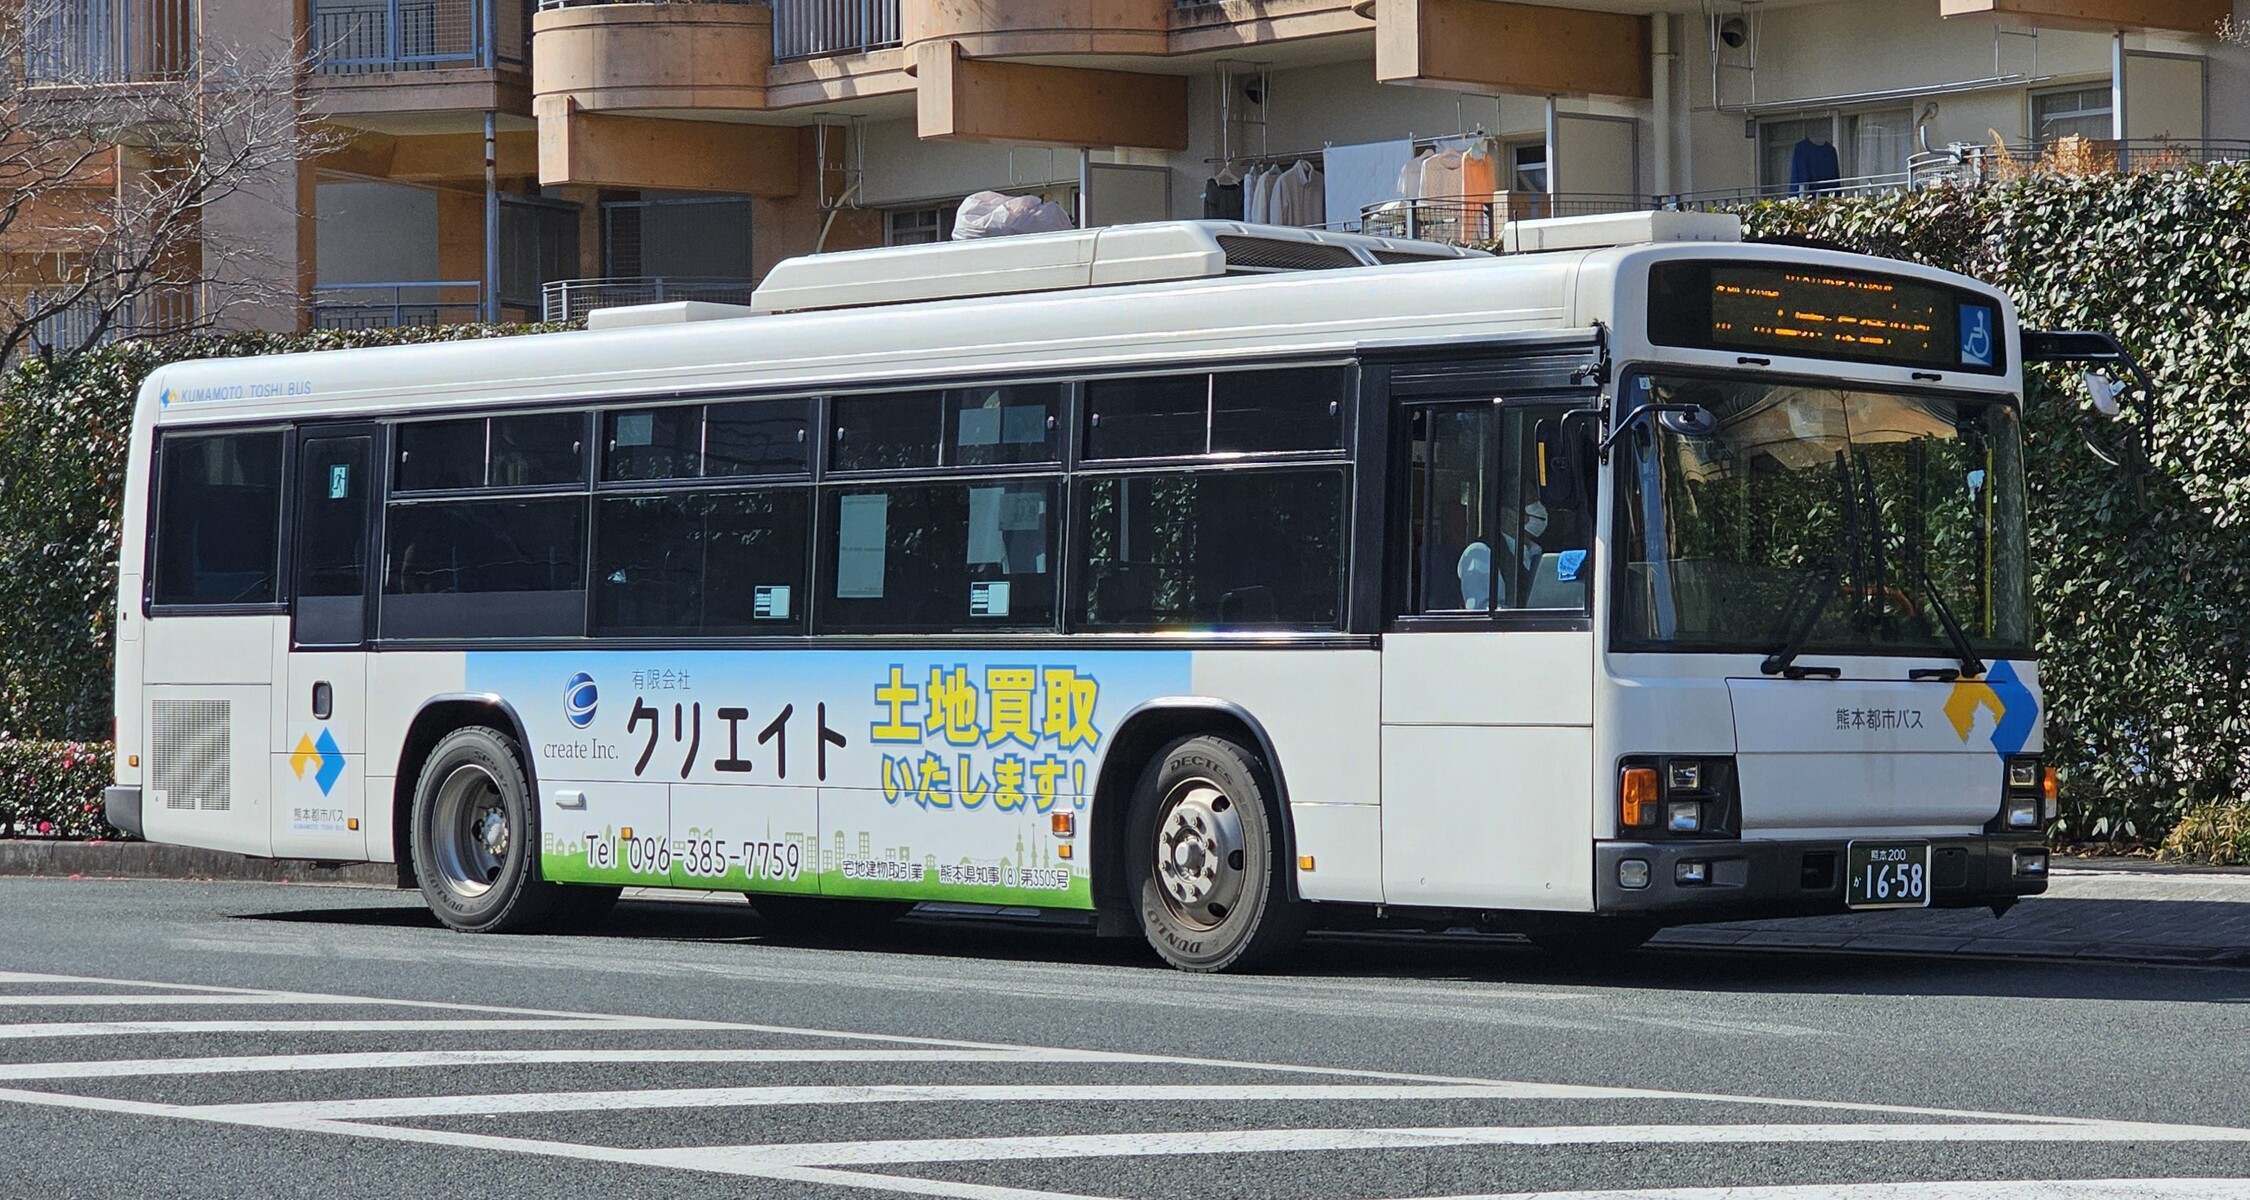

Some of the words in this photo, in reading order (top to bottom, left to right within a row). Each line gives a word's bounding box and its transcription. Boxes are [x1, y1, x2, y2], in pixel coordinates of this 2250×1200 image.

[181, 385, 243, 403] KUMAMOTO
[250, 382, 284, 398] TOSHI
[288, 380, 312, 396] BUS
[632, 669, 691, 690] 有限会社
[870, 663, 1102, 753] 土地買取
[1836, 708, 1923, 731] 熊本都市バス
[543, 739, 588, 759] create
[591, 738, 619, 759] Inc.
[627, 696, 847, 781] クリエイト
[294, 808, 344, 822] 熊本都市バス
[586, 835, 616, 865] Tel
[629, 837, 799, 878] 096-385-7759
[842, 861, 923, 881] 宅地建物取引業
[940, 864, 1000, 884] 熊本県知事
[1021, 868, 1069, 888] 第3505号
[1866, 863, 1923, 898] 16-58
